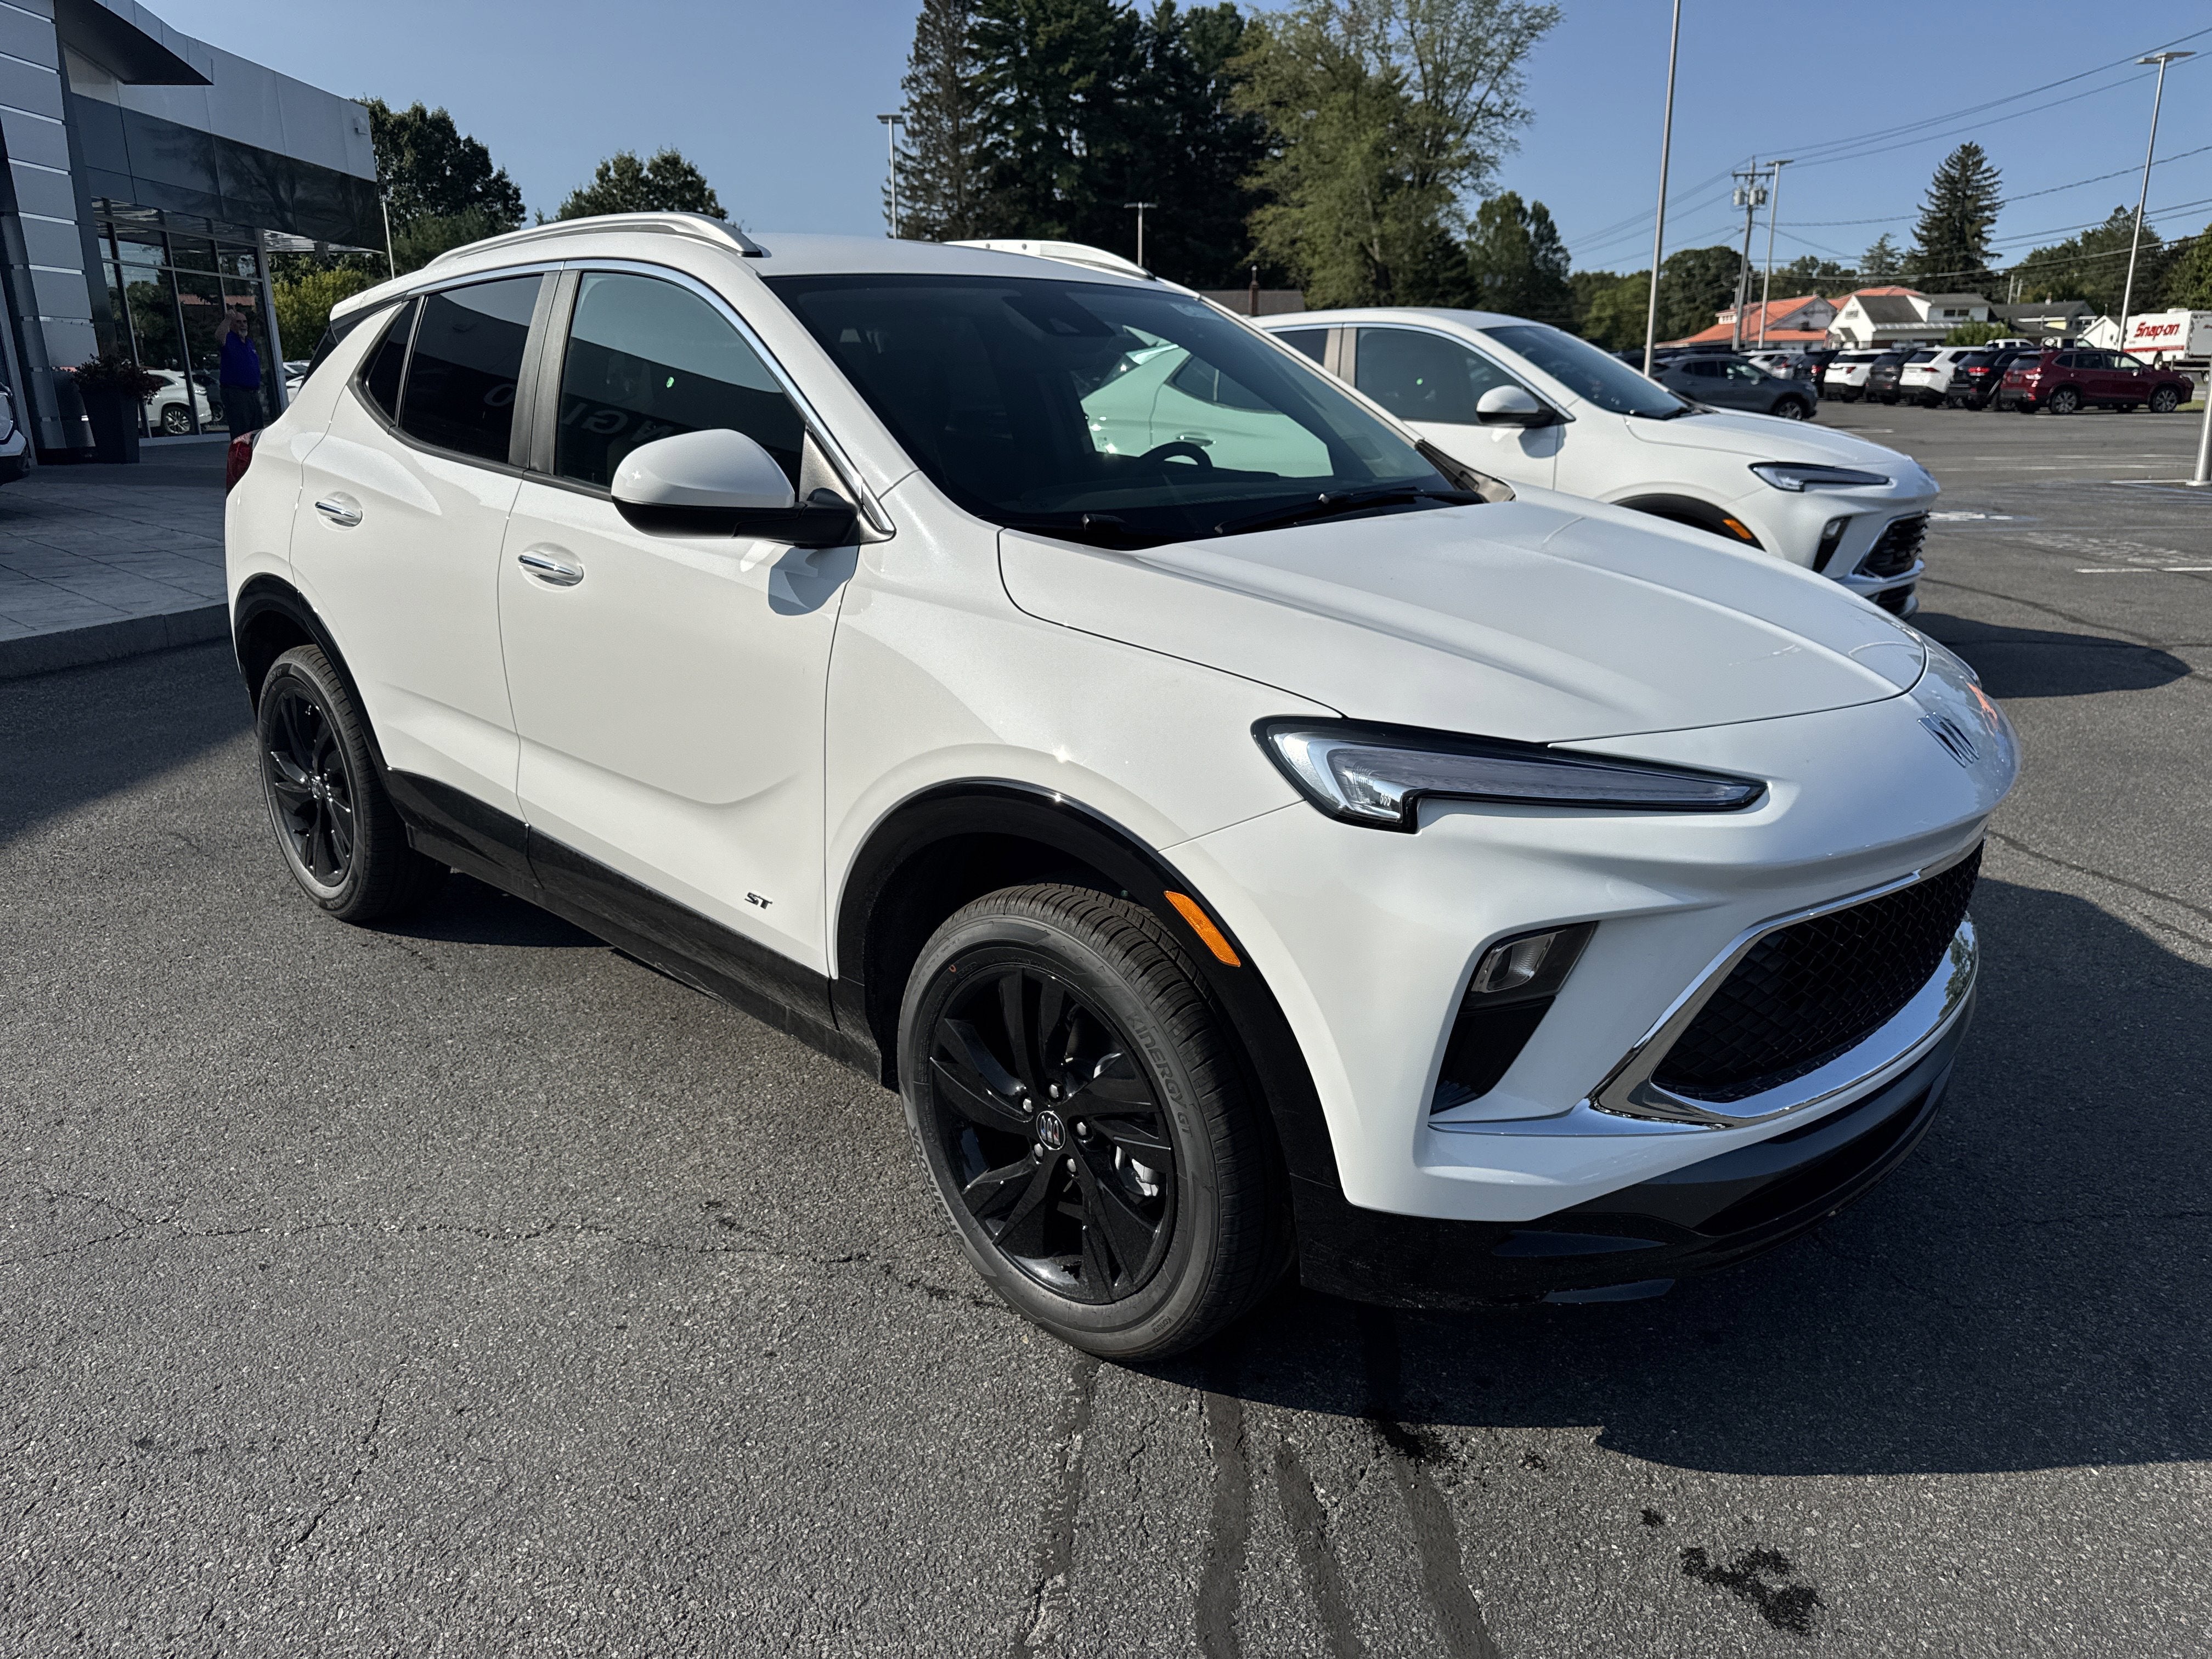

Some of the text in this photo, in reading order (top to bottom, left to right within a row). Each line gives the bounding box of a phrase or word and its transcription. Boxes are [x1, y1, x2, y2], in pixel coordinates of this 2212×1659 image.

[2134, 321, 2180, 341] Snap-on
[744, 891, 773, 910] ST
[1126, 1011, 1193, 1138] KINERGY GT
